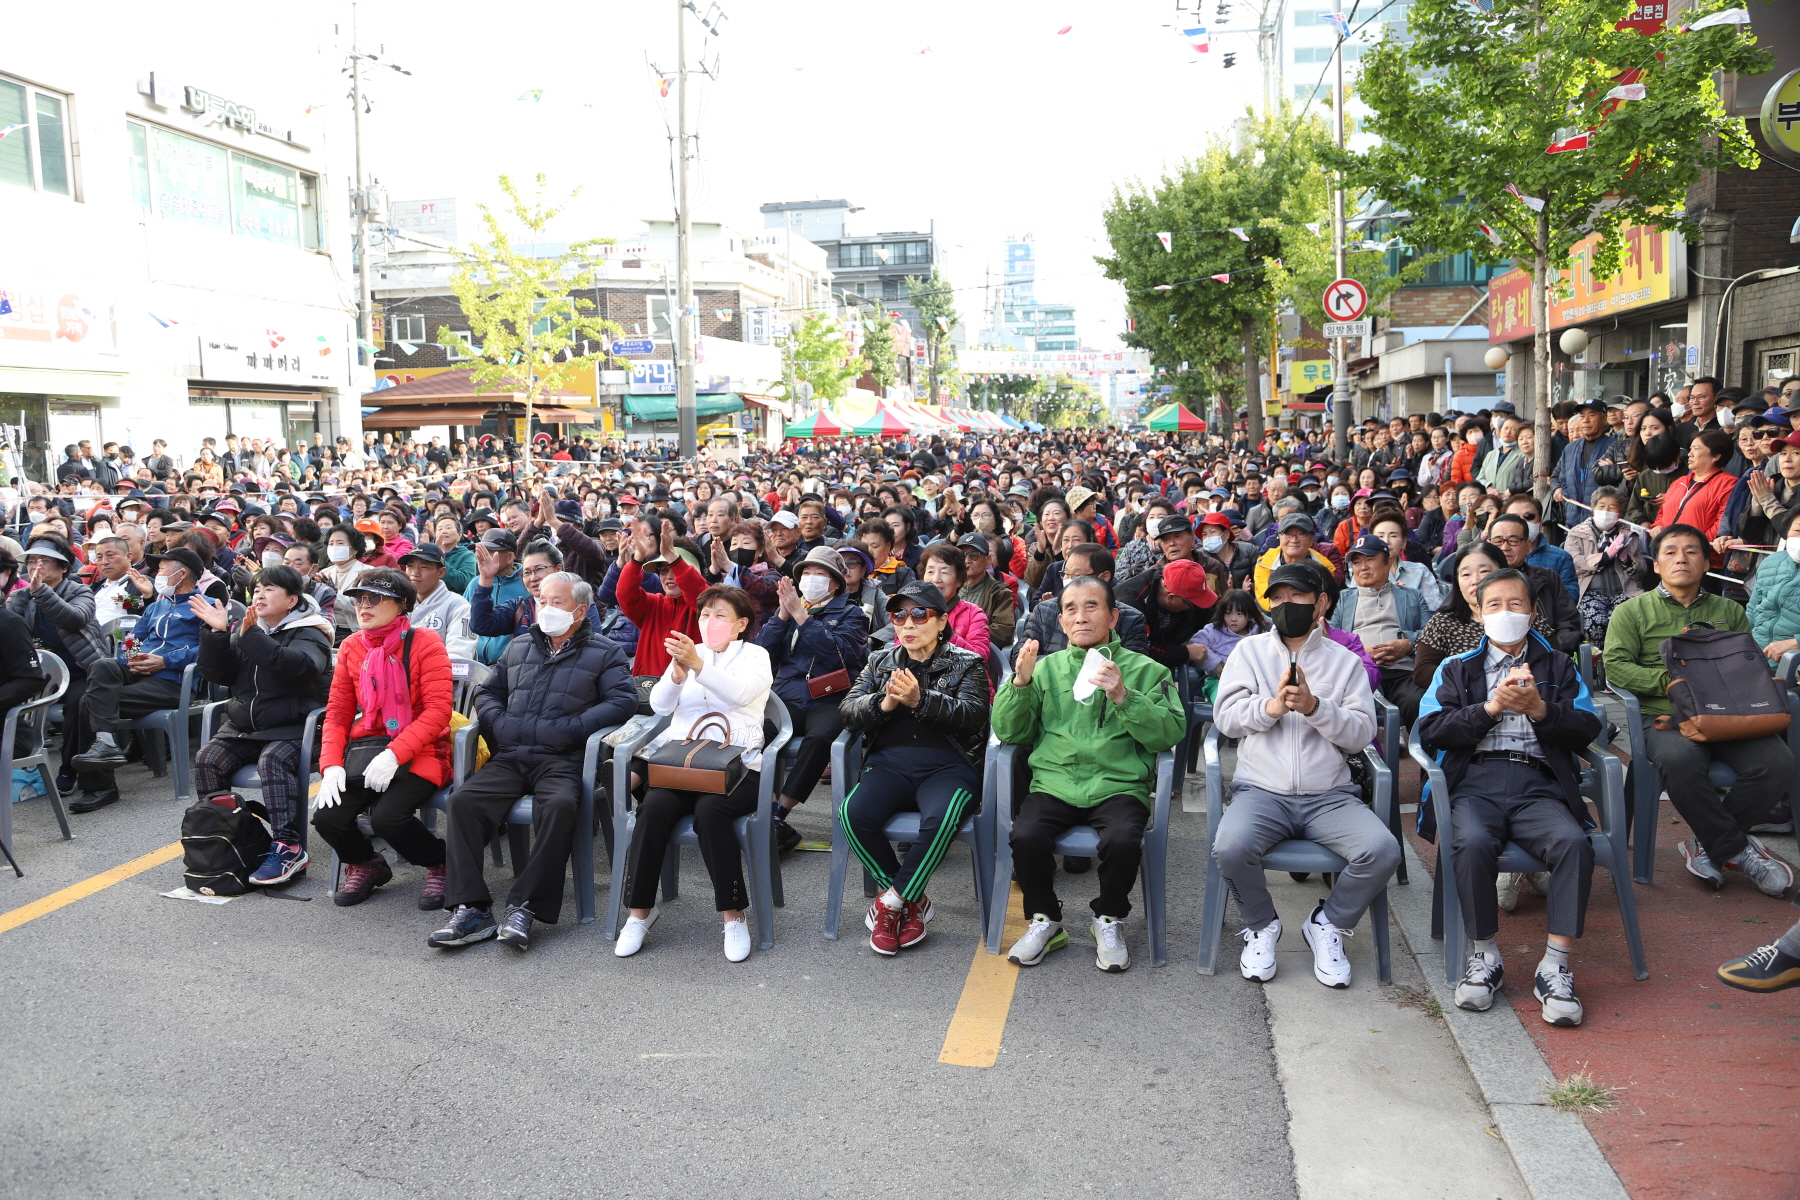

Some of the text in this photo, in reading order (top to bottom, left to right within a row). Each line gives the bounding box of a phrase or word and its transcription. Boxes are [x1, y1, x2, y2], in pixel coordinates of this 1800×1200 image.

[421, 204, 435, 213] PT
[1327, 324, 1364, 335] 일방통행
[246, 352, 300, 372] 까까머리
